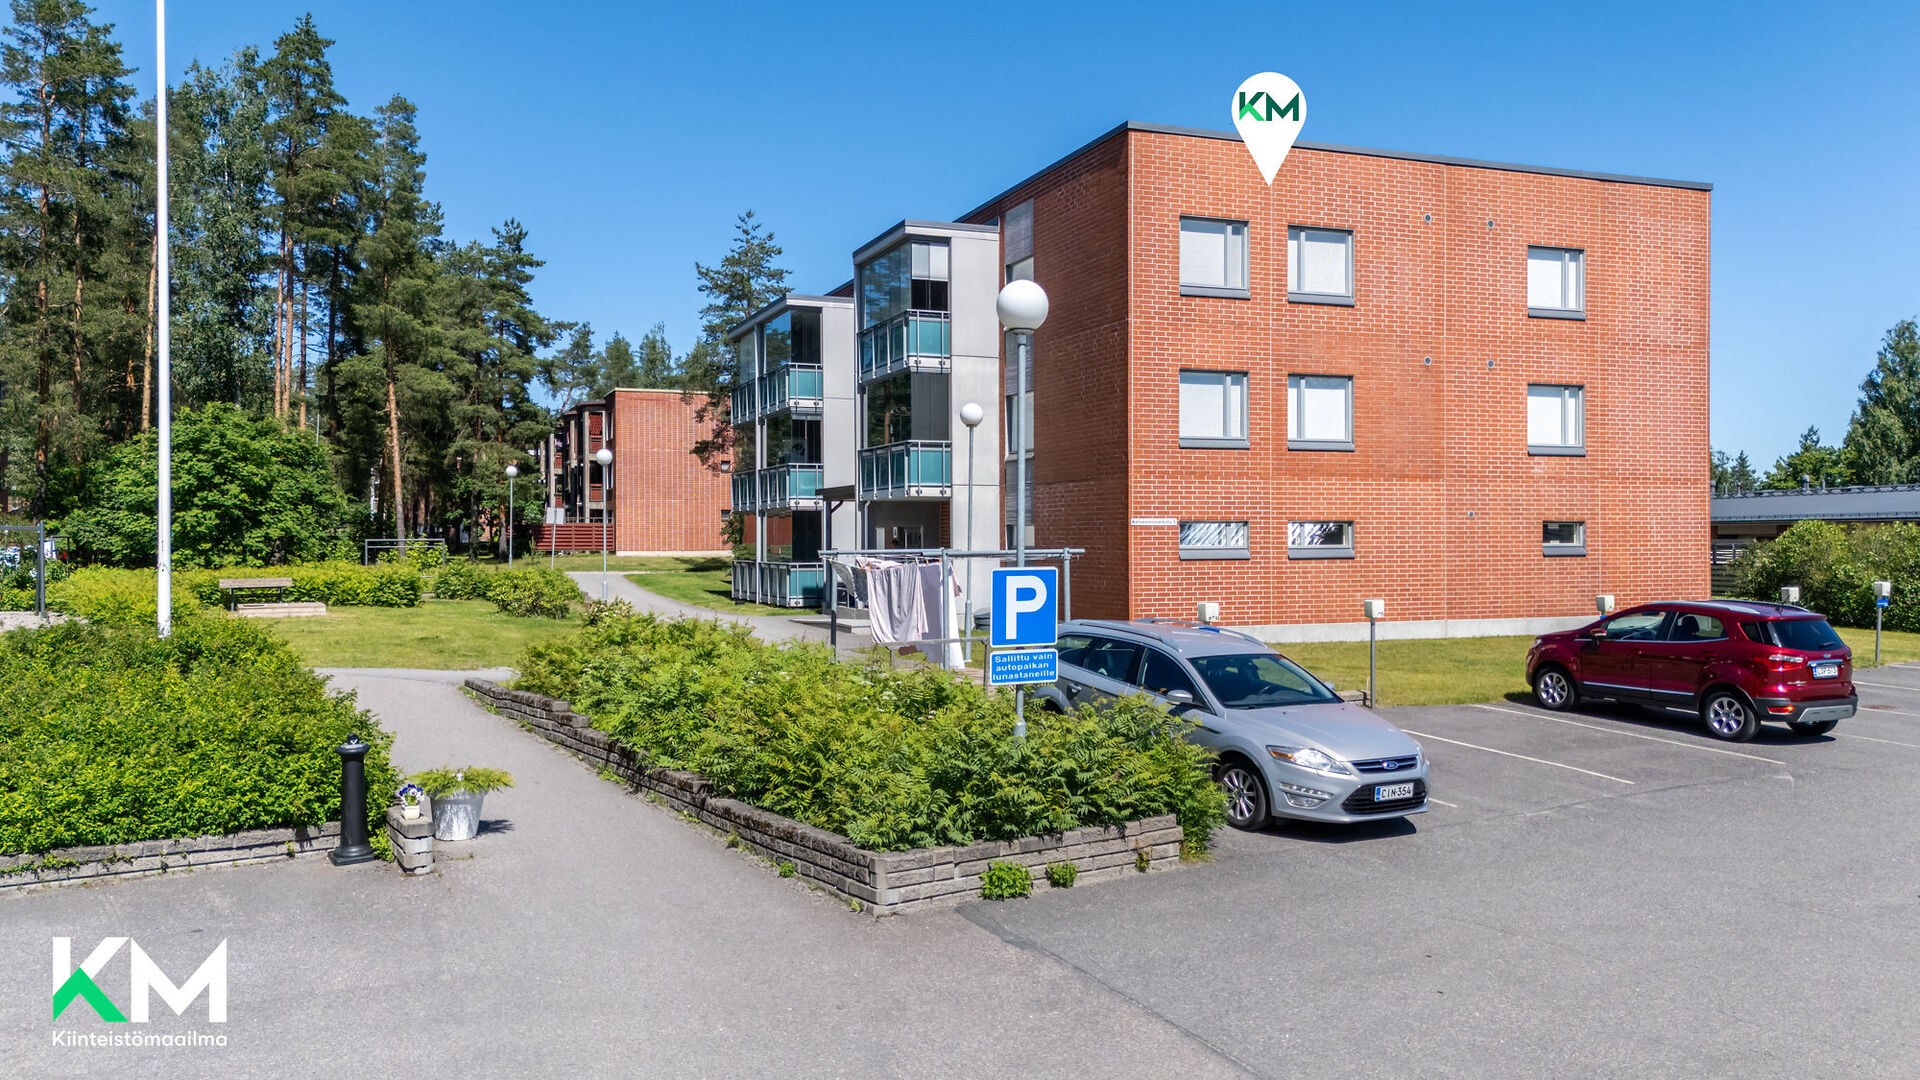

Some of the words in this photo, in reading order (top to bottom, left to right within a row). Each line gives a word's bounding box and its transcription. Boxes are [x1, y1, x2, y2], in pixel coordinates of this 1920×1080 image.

[1005, 575, 1047, 640] P
[994, 655, 1030, 663] Sallittu
[1032, 653, 1053, 661] vain
[995, 661, 1049, 672] autopaikan
[992, 670, 1055, 681] lunastaneille
[1381, 786, 1411, 798] CIN-354
